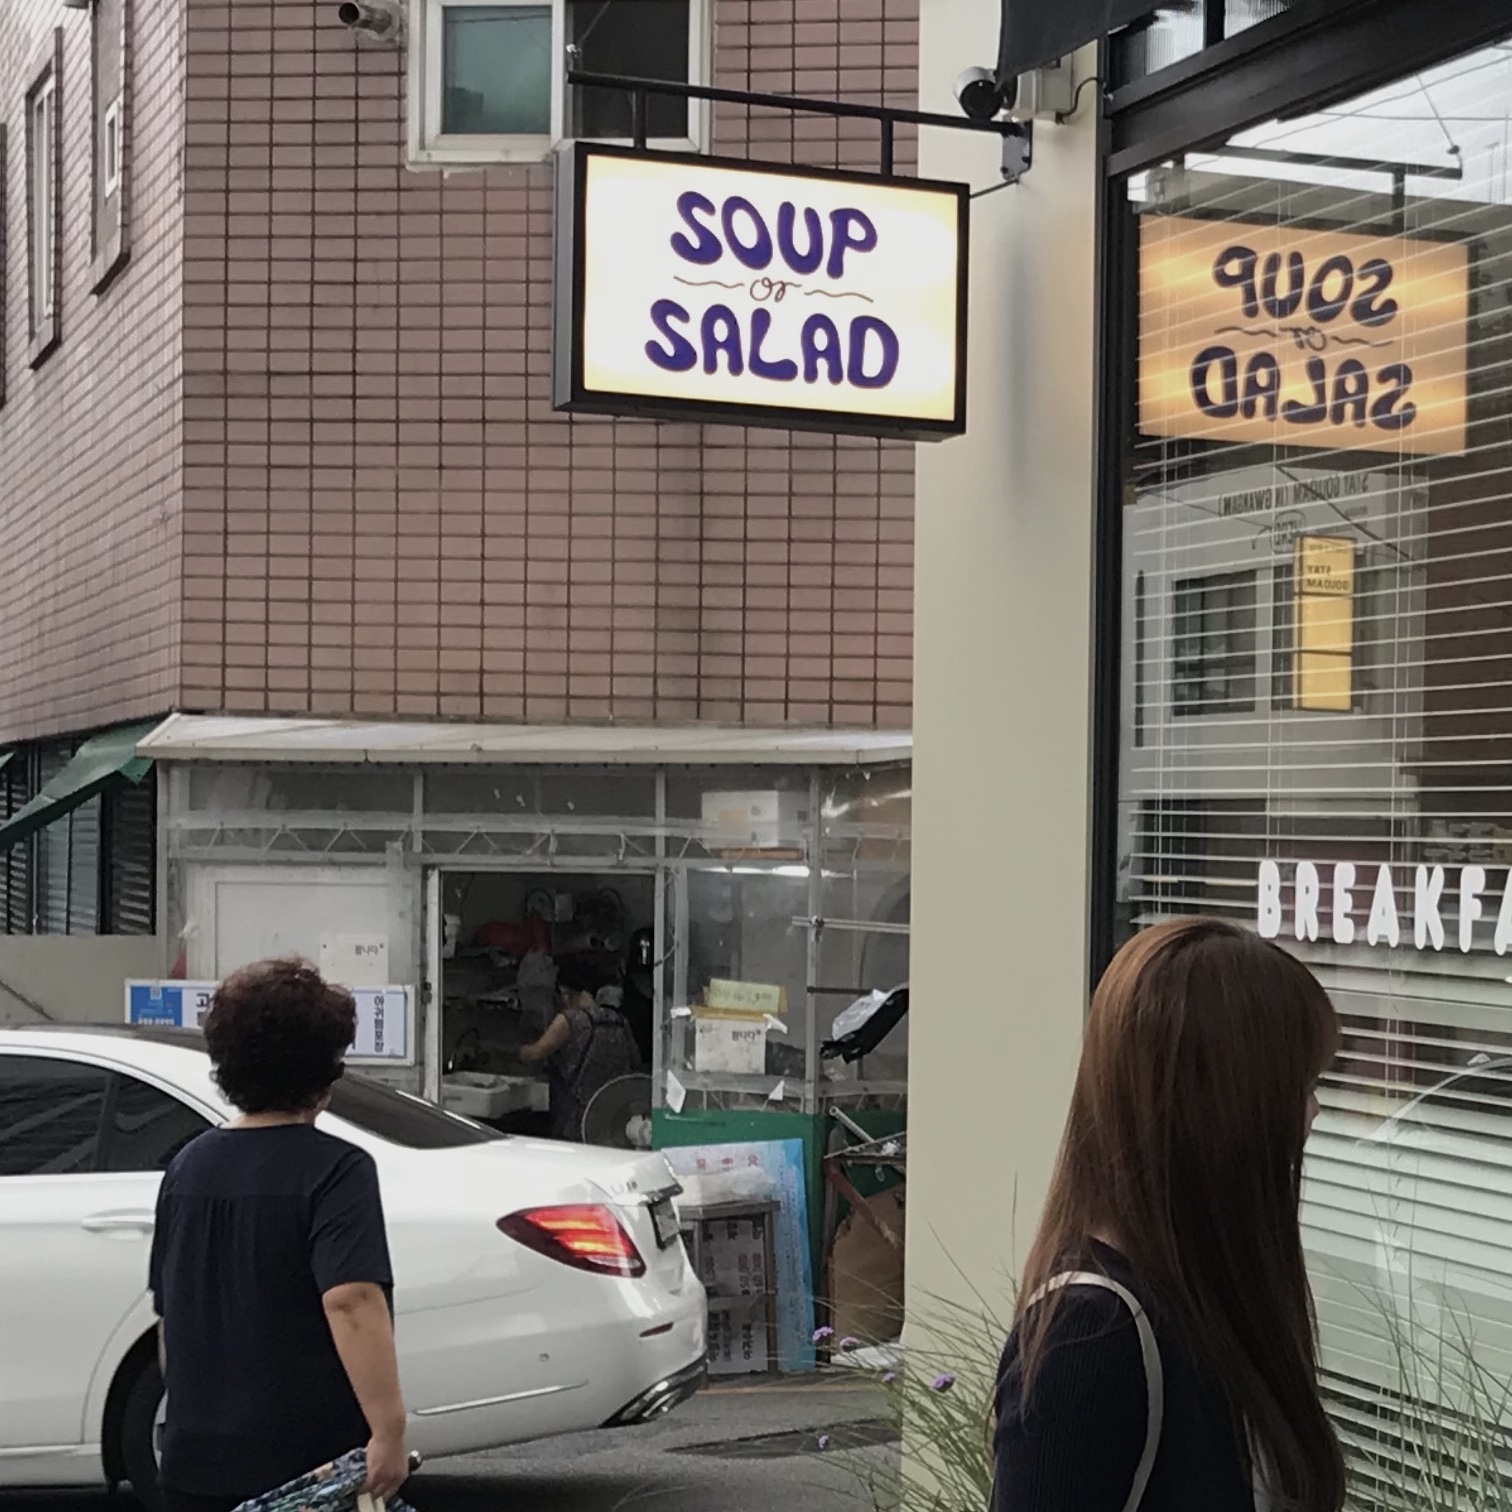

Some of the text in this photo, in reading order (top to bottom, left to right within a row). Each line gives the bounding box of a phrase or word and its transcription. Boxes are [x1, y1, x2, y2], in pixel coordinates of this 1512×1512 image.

[670, 191, 878, 278] SOUP
[749, 277, 802, 302] or
[645, 298, 900, 389] SALAD
